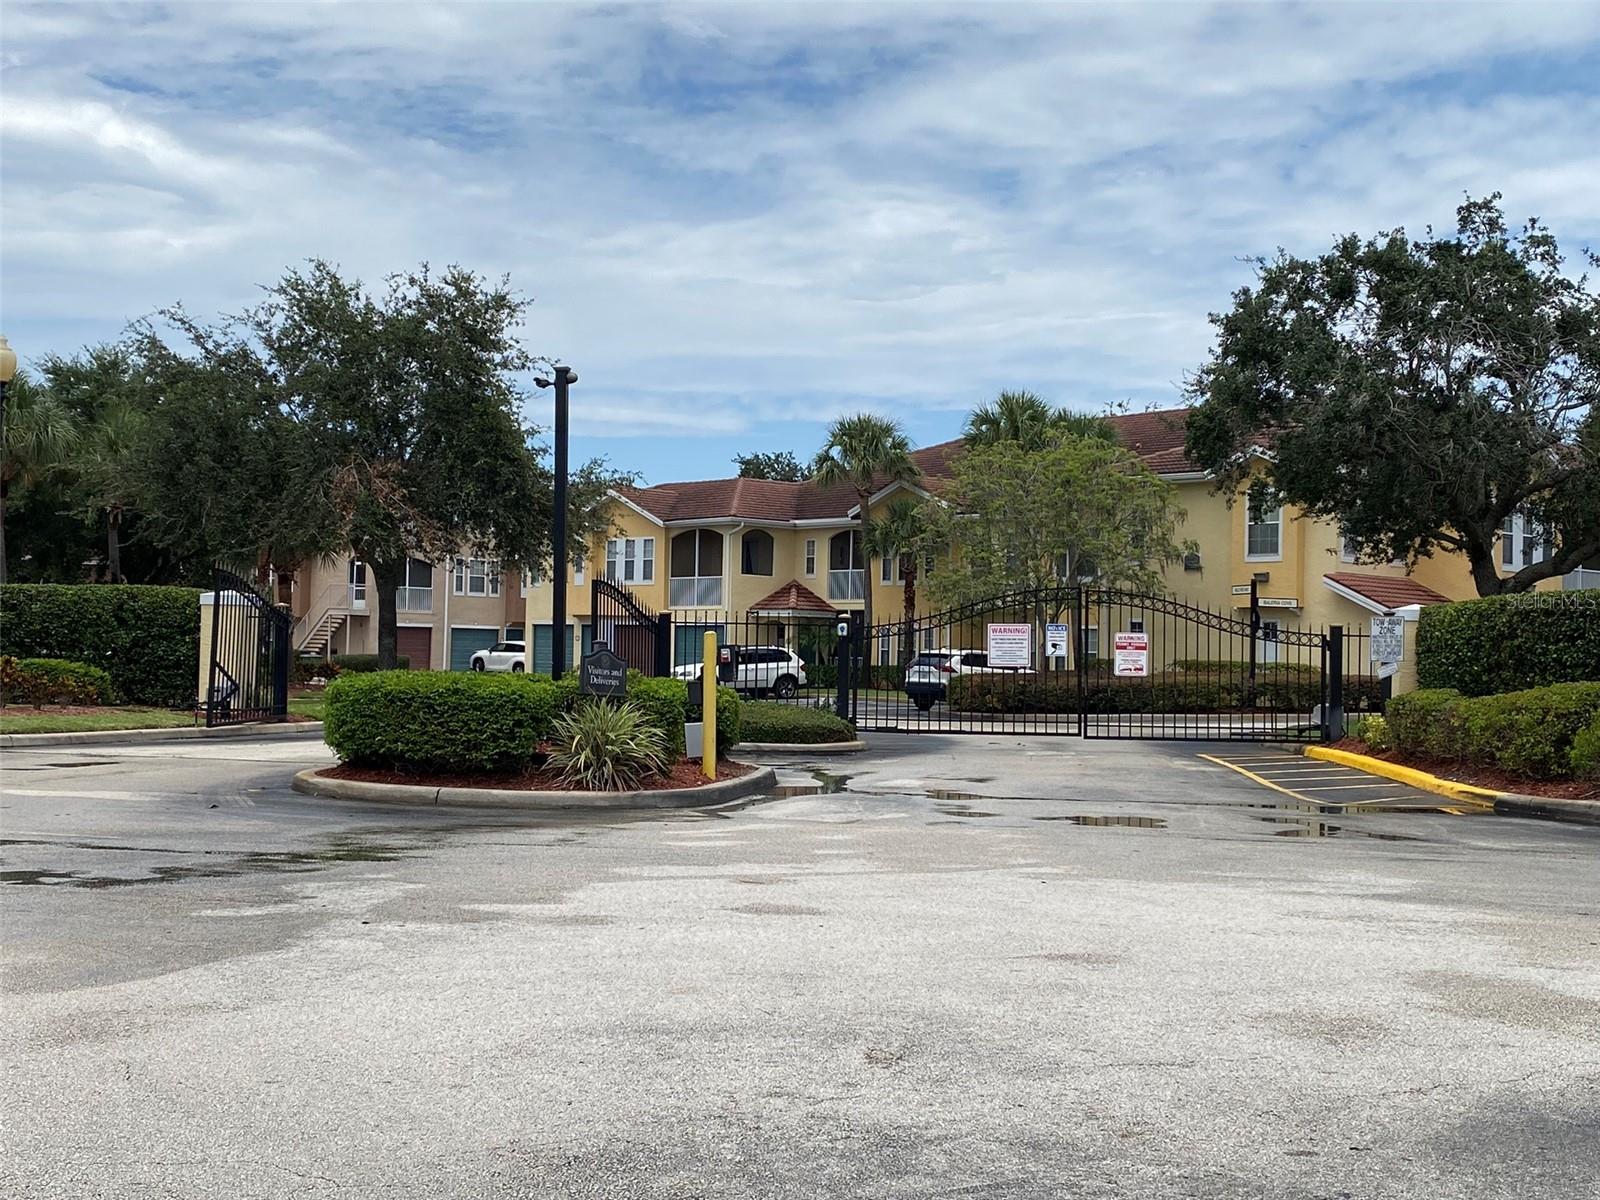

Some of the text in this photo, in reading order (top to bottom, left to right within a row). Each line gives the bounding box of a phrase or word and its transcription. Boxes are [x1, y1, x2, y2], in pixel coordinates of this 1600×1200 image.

[1379, 626, 1396, 635] ZONE
[588, 665, 622, 677] Visitors and
[591, 675, 619, 686] Deliveries
